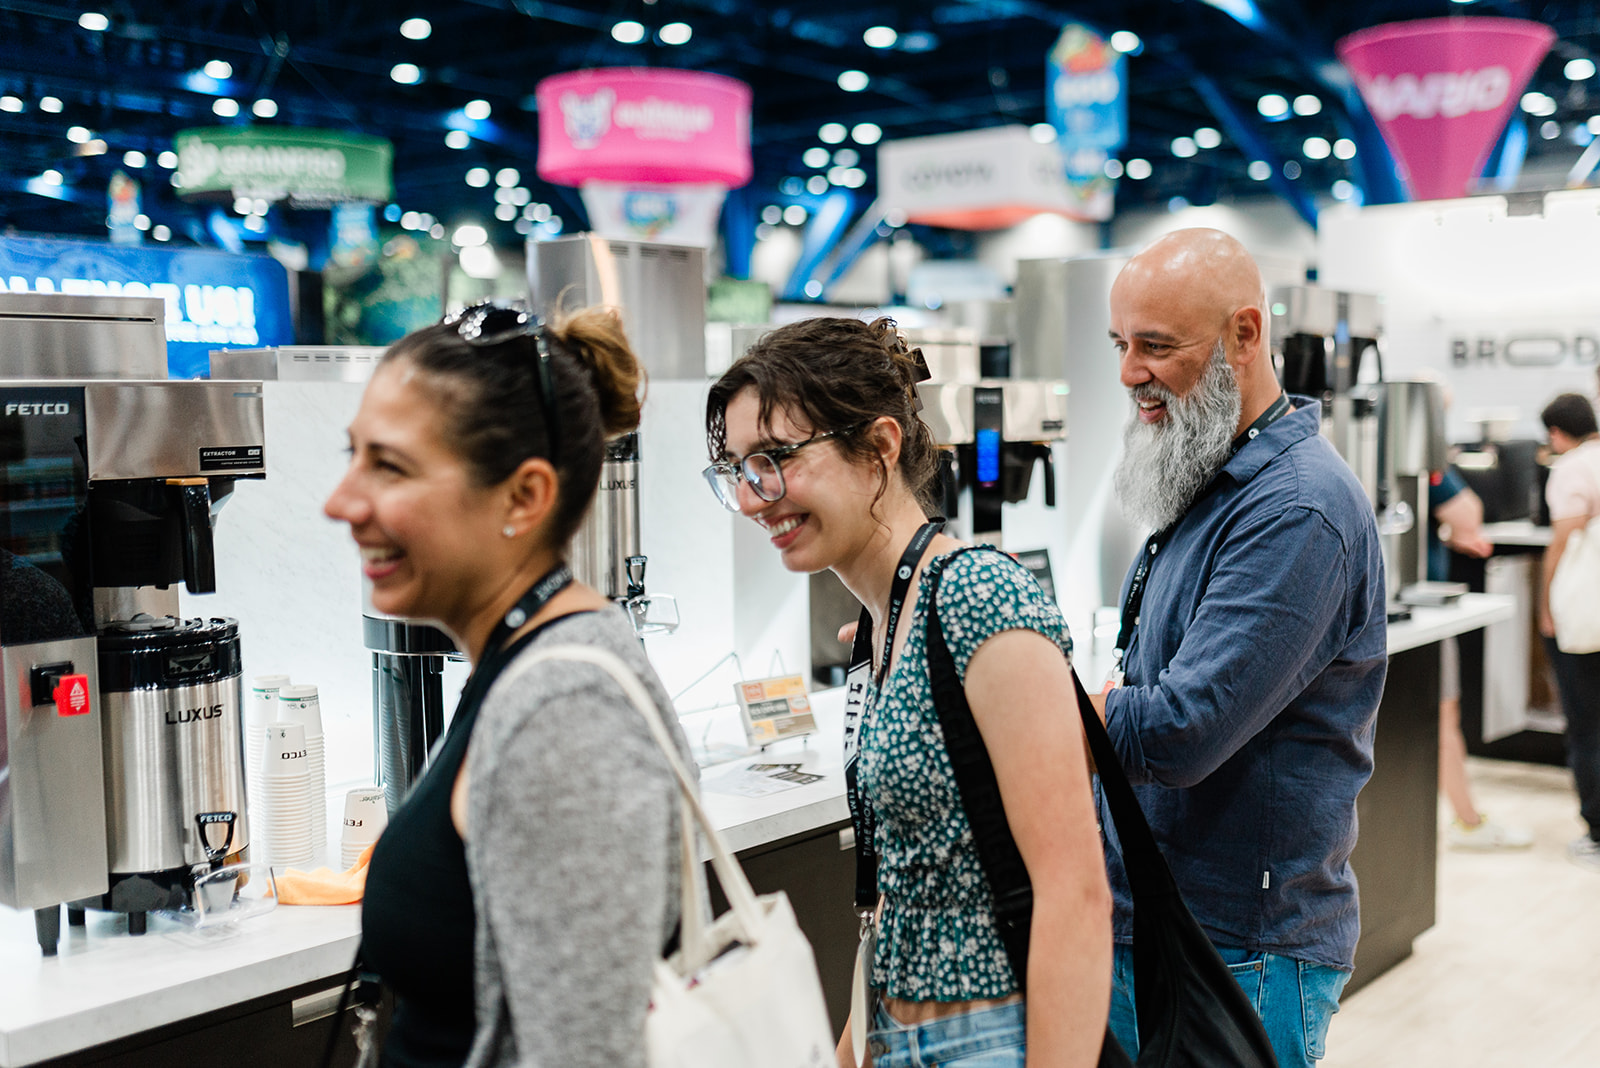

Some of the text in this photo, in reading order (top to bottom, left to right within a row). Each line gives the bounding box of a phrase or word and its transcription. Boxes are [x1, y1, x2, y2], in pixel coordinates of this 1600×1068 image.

[5, 403, 70, 415] FETCO
[599, 480, 635, 490] LUXUS
[165, 704, 224, 725] LUXUS
[200, 813, 232, 823] FETCO
